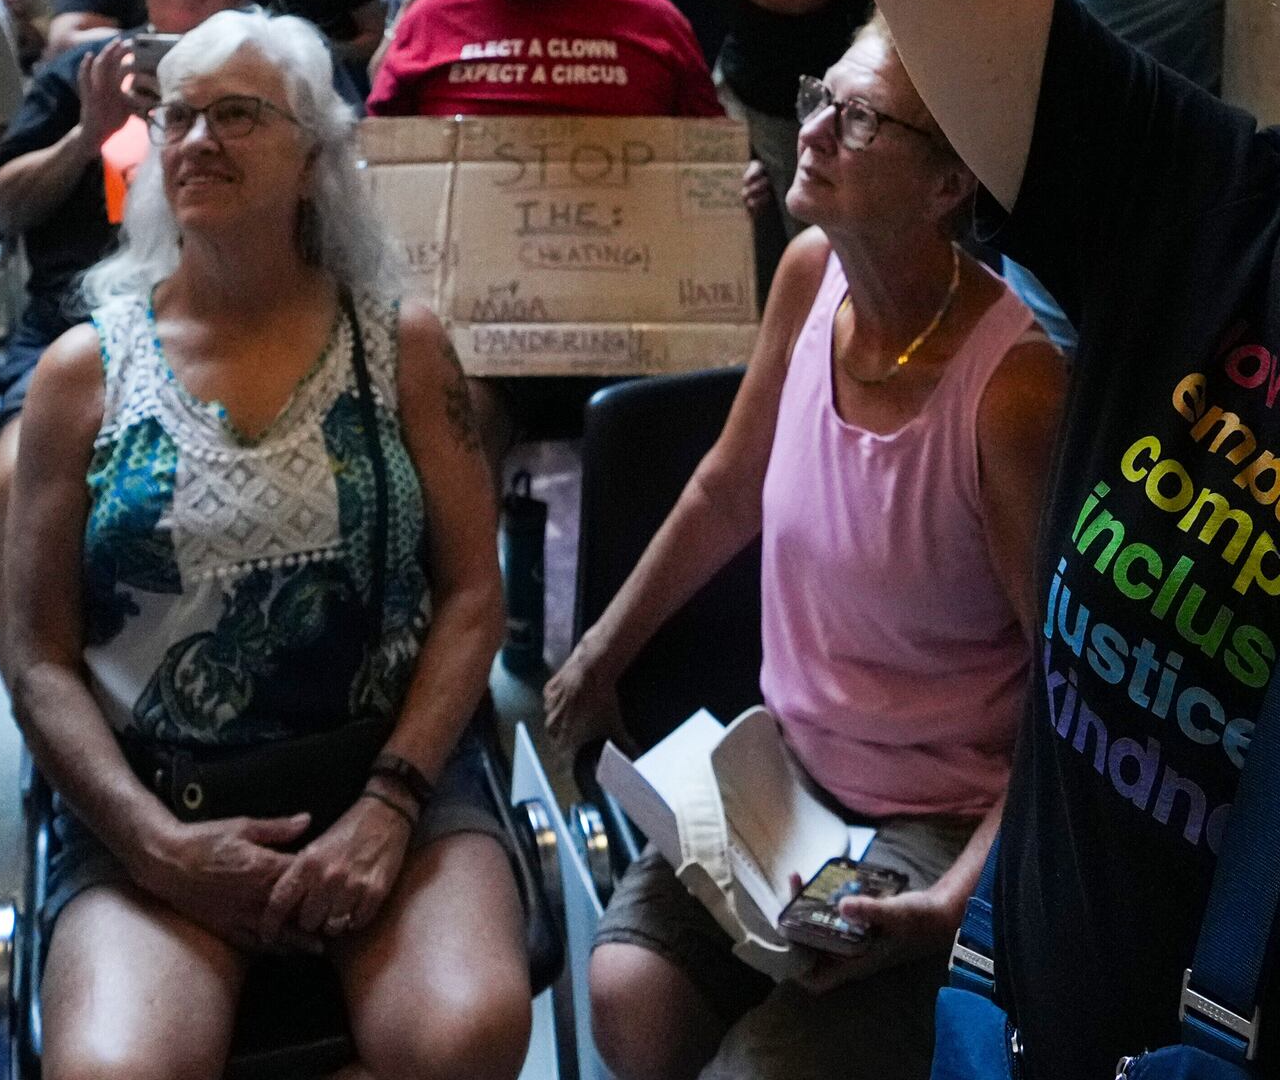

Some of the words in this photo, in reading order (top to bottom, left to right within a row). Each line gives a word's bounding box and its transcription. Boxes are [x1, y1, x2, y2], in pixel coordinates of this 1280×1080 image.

[460, 39, 524, 59] ELECT
[528, 40, 544, 58] A
[546, 39, 618, 58] CLOWN
[449, 65, 526, 84] EXPECT
[531, 66, 547, 84] A
[551, 65, 629, 85] CIRCUS
[492, 141, 655, 188] STOP
